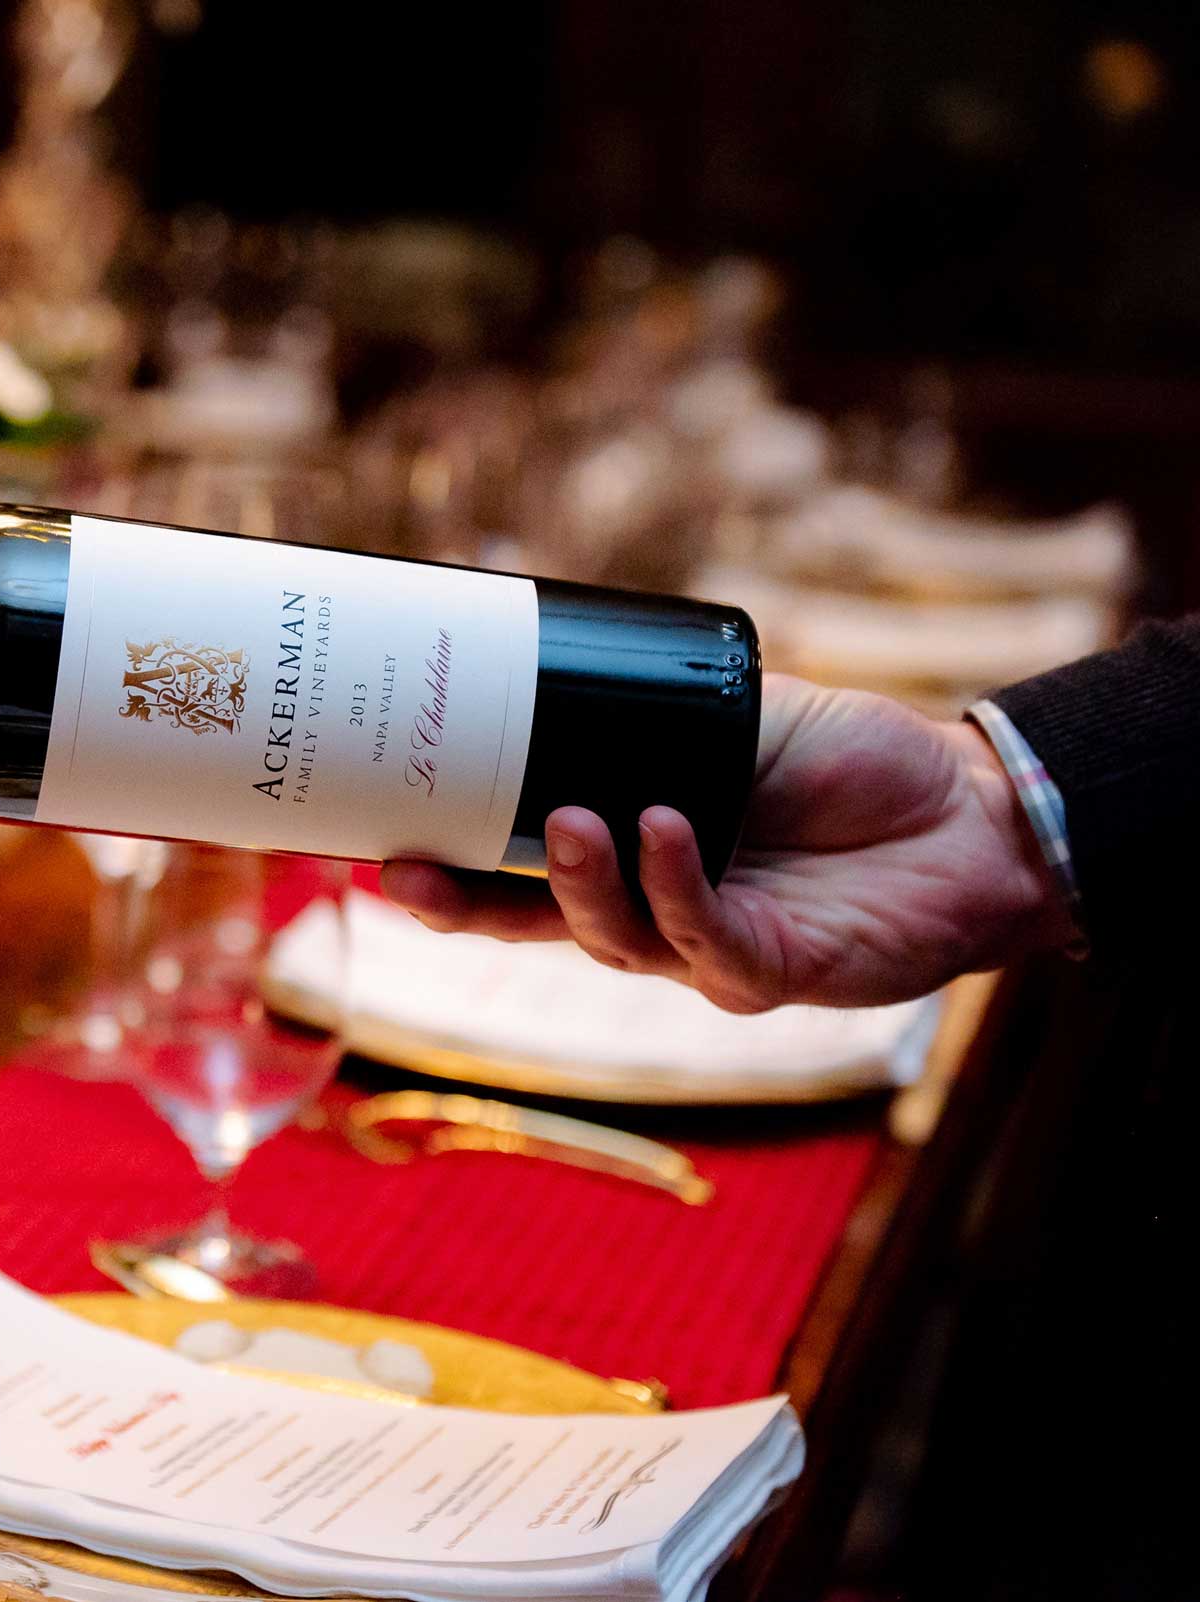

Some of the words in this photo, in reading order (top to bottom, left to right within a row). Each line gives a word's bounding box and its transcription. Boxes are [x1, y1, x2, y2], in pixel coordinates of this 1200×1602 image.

[251, 590, 306, 800] ACKERMAN
[293, 730, 318, 803] FAMILY
[308, 595, 332, 718] VINEYARDS
[349, 683, 367, 727] 2013
[379, 654, 396, 713] VALLEY
[411, 628, 453, 749] Chatelaine
[372, 721, 389, 762] NAPA
[404, 754, 437, 798] Le
